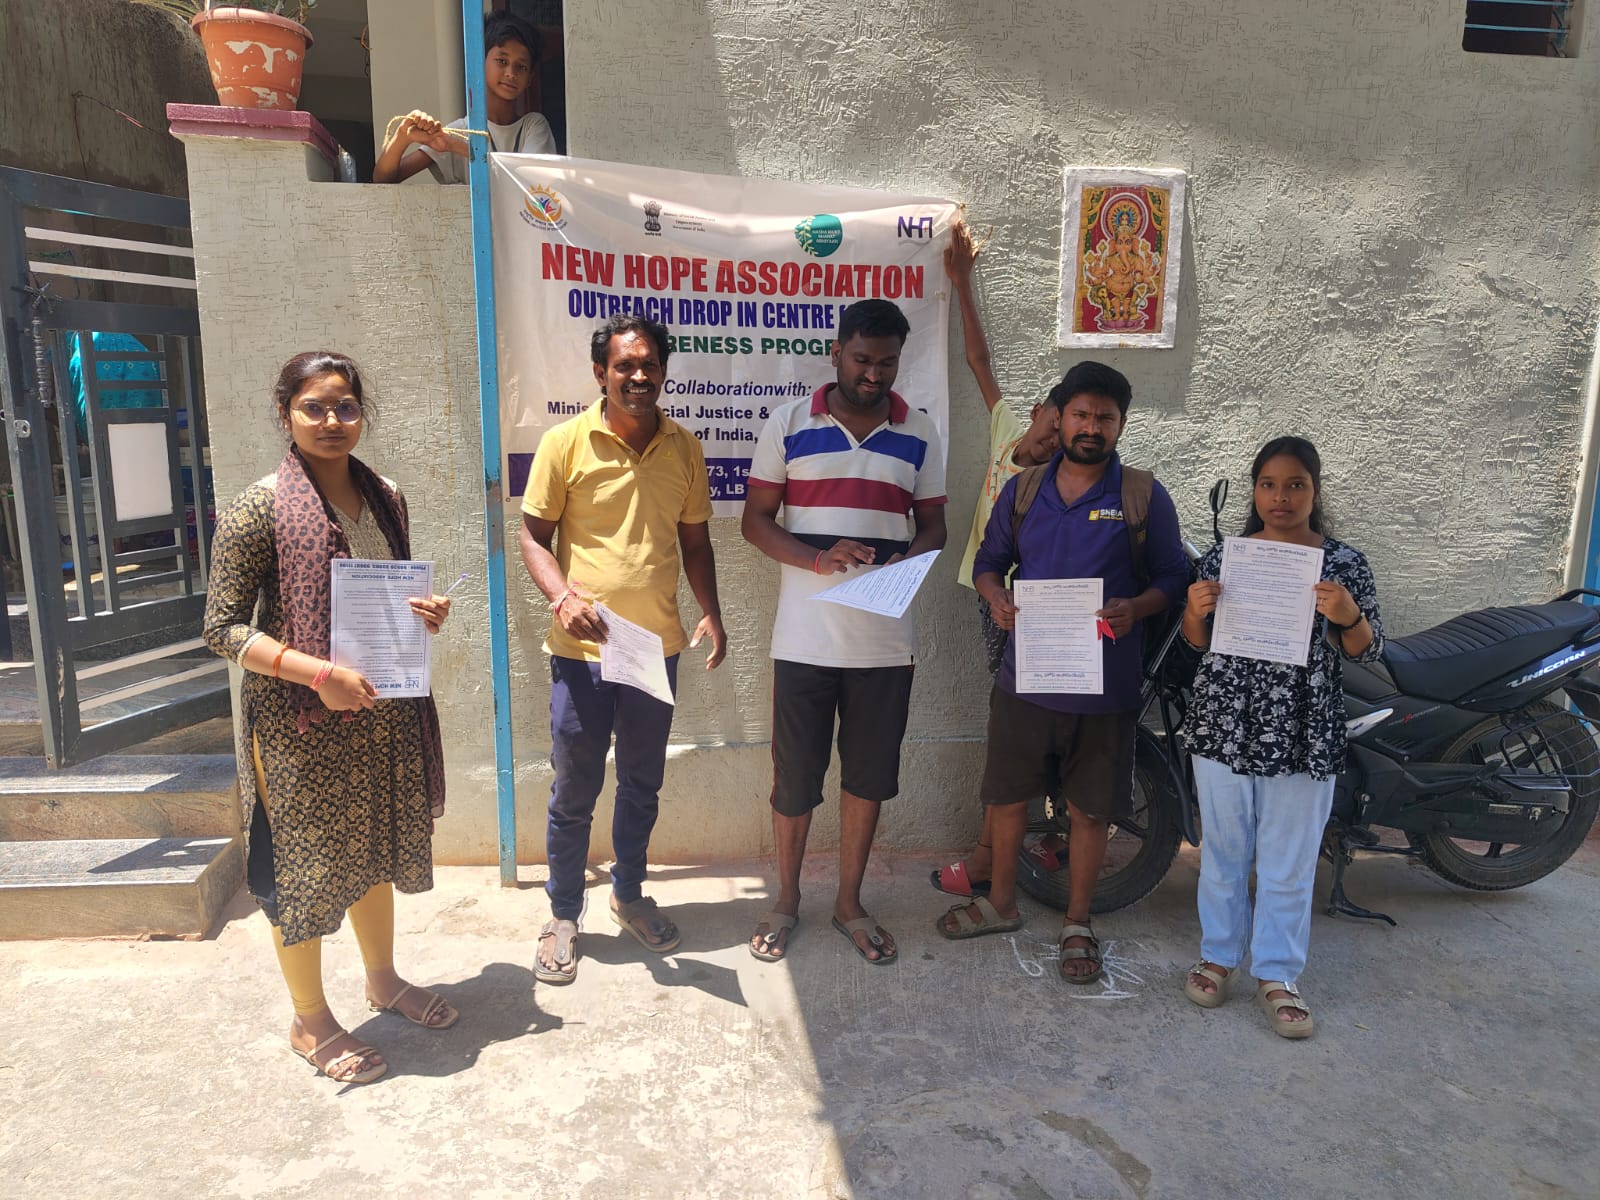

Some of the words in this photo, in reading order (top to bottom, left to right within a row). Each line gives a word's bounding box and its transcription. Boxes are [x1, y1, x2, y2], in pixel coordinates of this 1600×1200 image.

[541, 242, 616, 288] NEW
[623, 253, 709, 293] HOPE
[714, 259, 925, 300] ASSOCIATION
[568, 287, 674, 325] OUTREACH
[678, 298, 733, 327] DROP
[737, 301, 757, 328] IN
[762, 301, 835, 329] CENTRE
[667, 334, 754, 355] RENESS
[760, 337, 833, 357] PROG
[547, 401, 590, 415] Minis
[662, 405, 690, 418] cial
[695, 404, 754, 420] Justice
[758, 406, 770, 420] &
[694, 427, 710, 441] of
[715, 427, 759, 444] India,
[733, 464, 749, 477] 1s
[726, 483, 745, 495] LB
[1505, 650, 1586, 688] UNICORN
